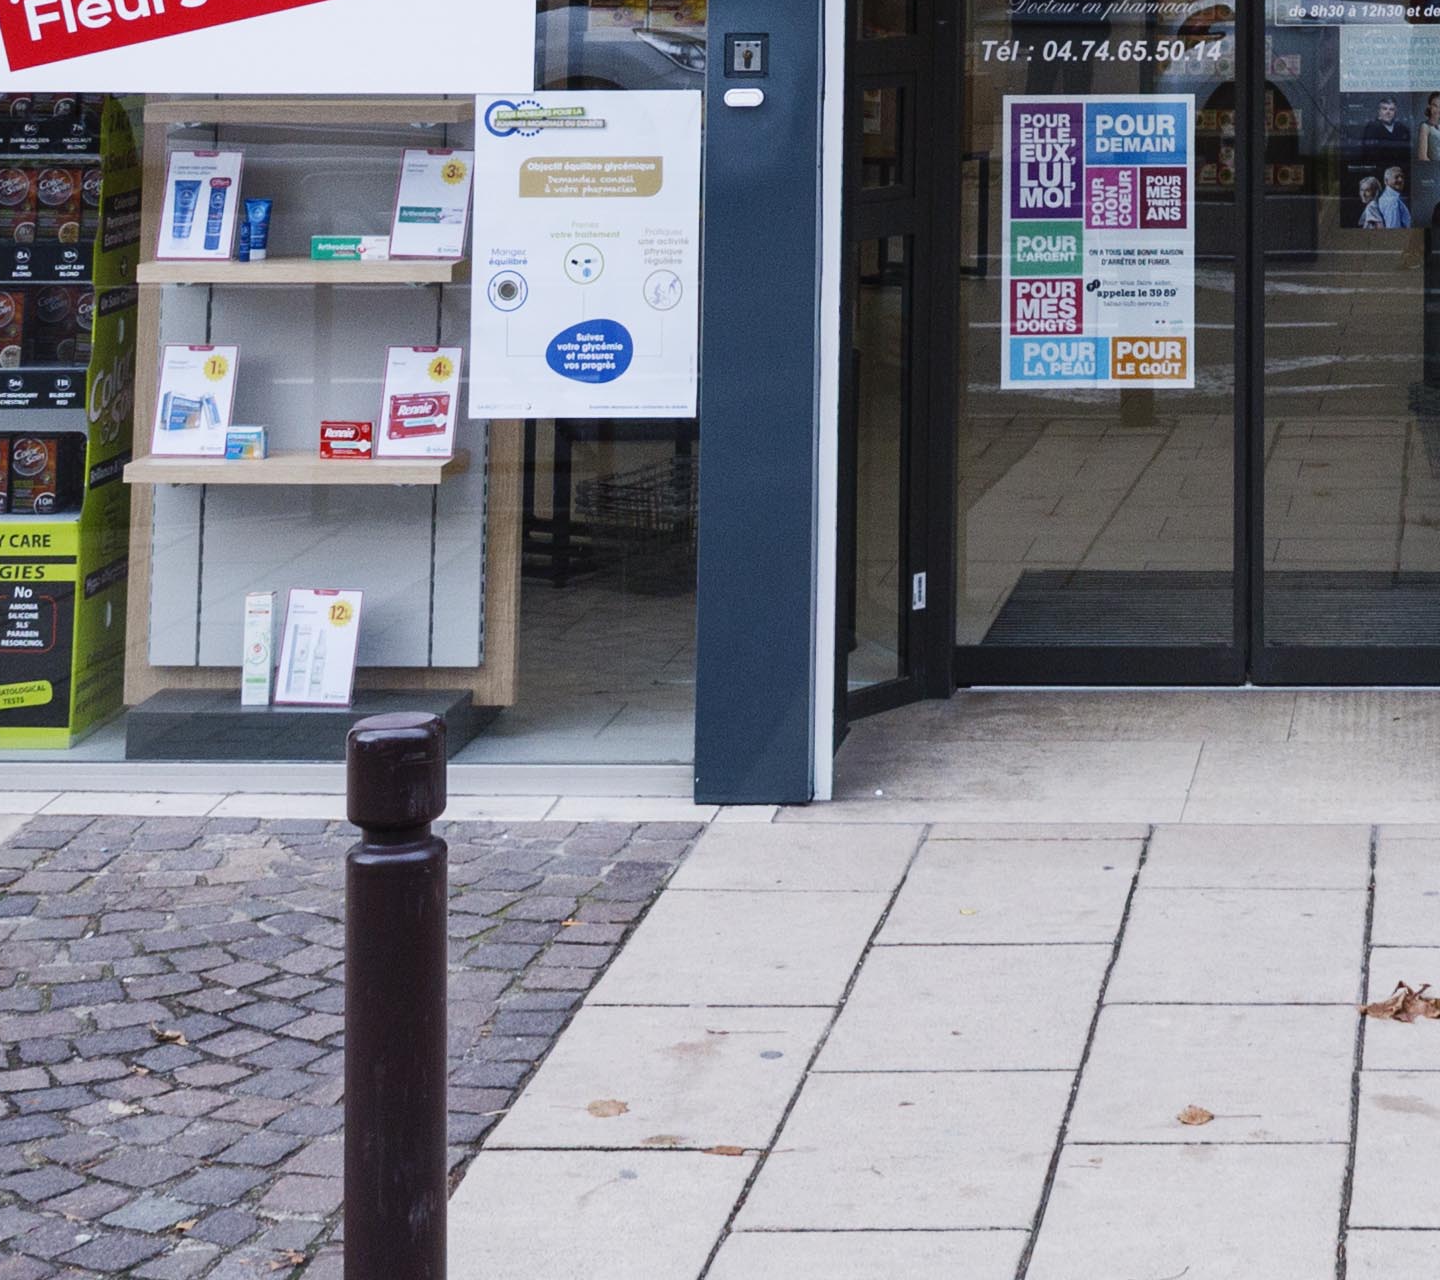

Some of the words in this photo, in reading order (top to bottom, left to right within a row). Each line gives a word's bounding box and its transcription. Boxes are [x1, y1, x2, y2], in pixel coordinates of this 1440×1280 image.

[1081, 0, 1101, 15] en
[1289, 4, 1306, 19] de
[1310, 4, 1344, 19] 8h30
[1347, 4, 1357, 19] à
[1361, 4, 1403, 19] 12h30
[1406, 5, 1420, 19] et
[1423, 4, 1440, 19] de
[981, 39, 1020, 62] Tél
[1041, 40, 1223, 63] 04.74.65.50.14
[1019, 113, 1071, 128] POUR
[1095, 115, 1175, 136] POUR
[1019, 128, 1076, 145] ELLE,
[1096, 137, 1176, 153] DEMAIN
[1019, 145, 1076, 164] EUX,
[1020, 162, 1076, 189] LUI,
[1146, 175, 1181, 186] POUR
[1019, 188, 1071, 208] MOI
[1118, 170, 1132, 226] COEUR
[1146, 186, 1181, 198] MES
[1091, 177, 1105, 226] POUR
[1105, 185, 1118, 226] MON
[1146, 207, 1181, 221] ANS
[1017, 236, 1077, 252] POUR
[1017, 282, 1077, 298] POUR
[1016, 298, 1077, 319] MES
[1017, 319, 1077, 332] DOIGTS
[1023, 341, 1096, 362] POUR
[1117, 341, 1182, 359] POUR
[1023, 362, 1046, 376] LA
[1050, 361, 1095, 376] PEAU
[1117, 363, 1138, 376] LE
[1140, 359, 1182, 376] GOÛT
[9, 534, 52, 548] CARE
[14, 587, 33, 598] No
